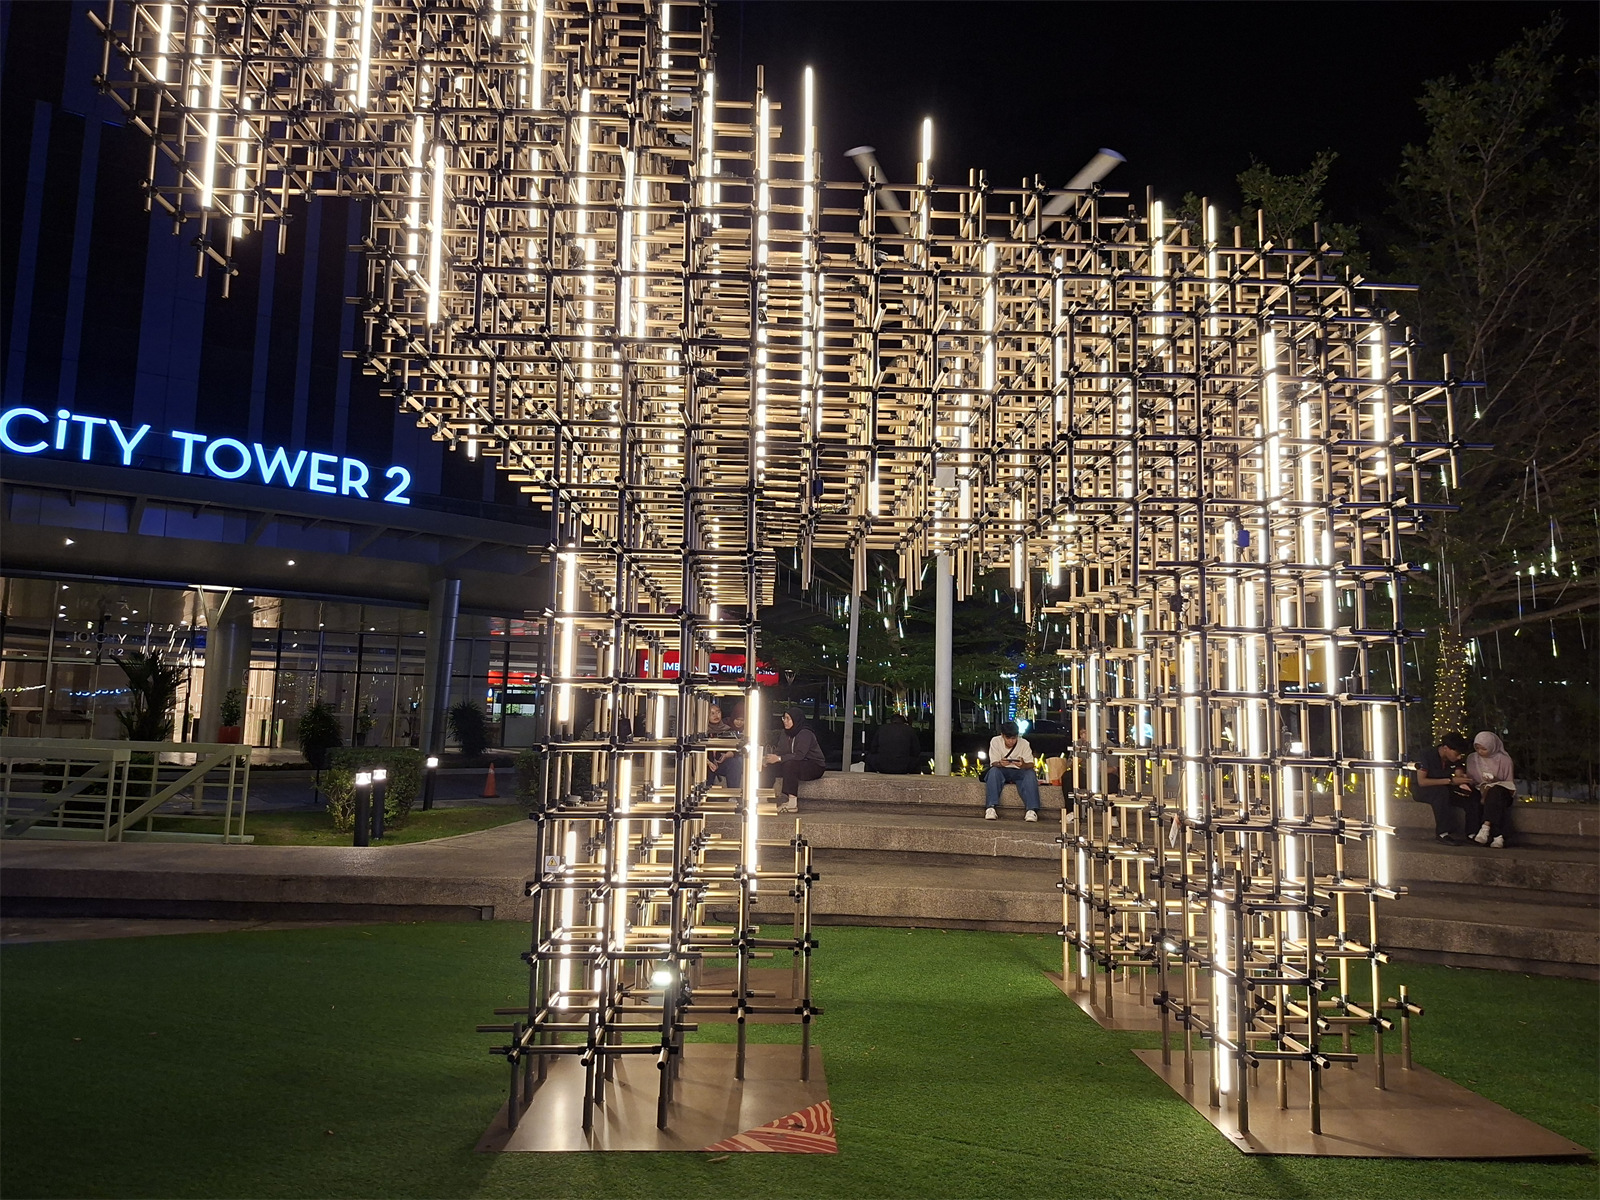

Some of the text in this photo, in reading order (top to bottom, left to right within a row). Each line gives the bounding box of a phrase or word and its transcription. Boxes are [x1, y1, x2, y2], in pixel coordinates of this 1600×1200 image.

[171, 430, 370, 499] TOWER
[383, 465, 411, 505] 2
[661, 661, 680, 671] IMB
[720, 664, 743, 674] CIMB
